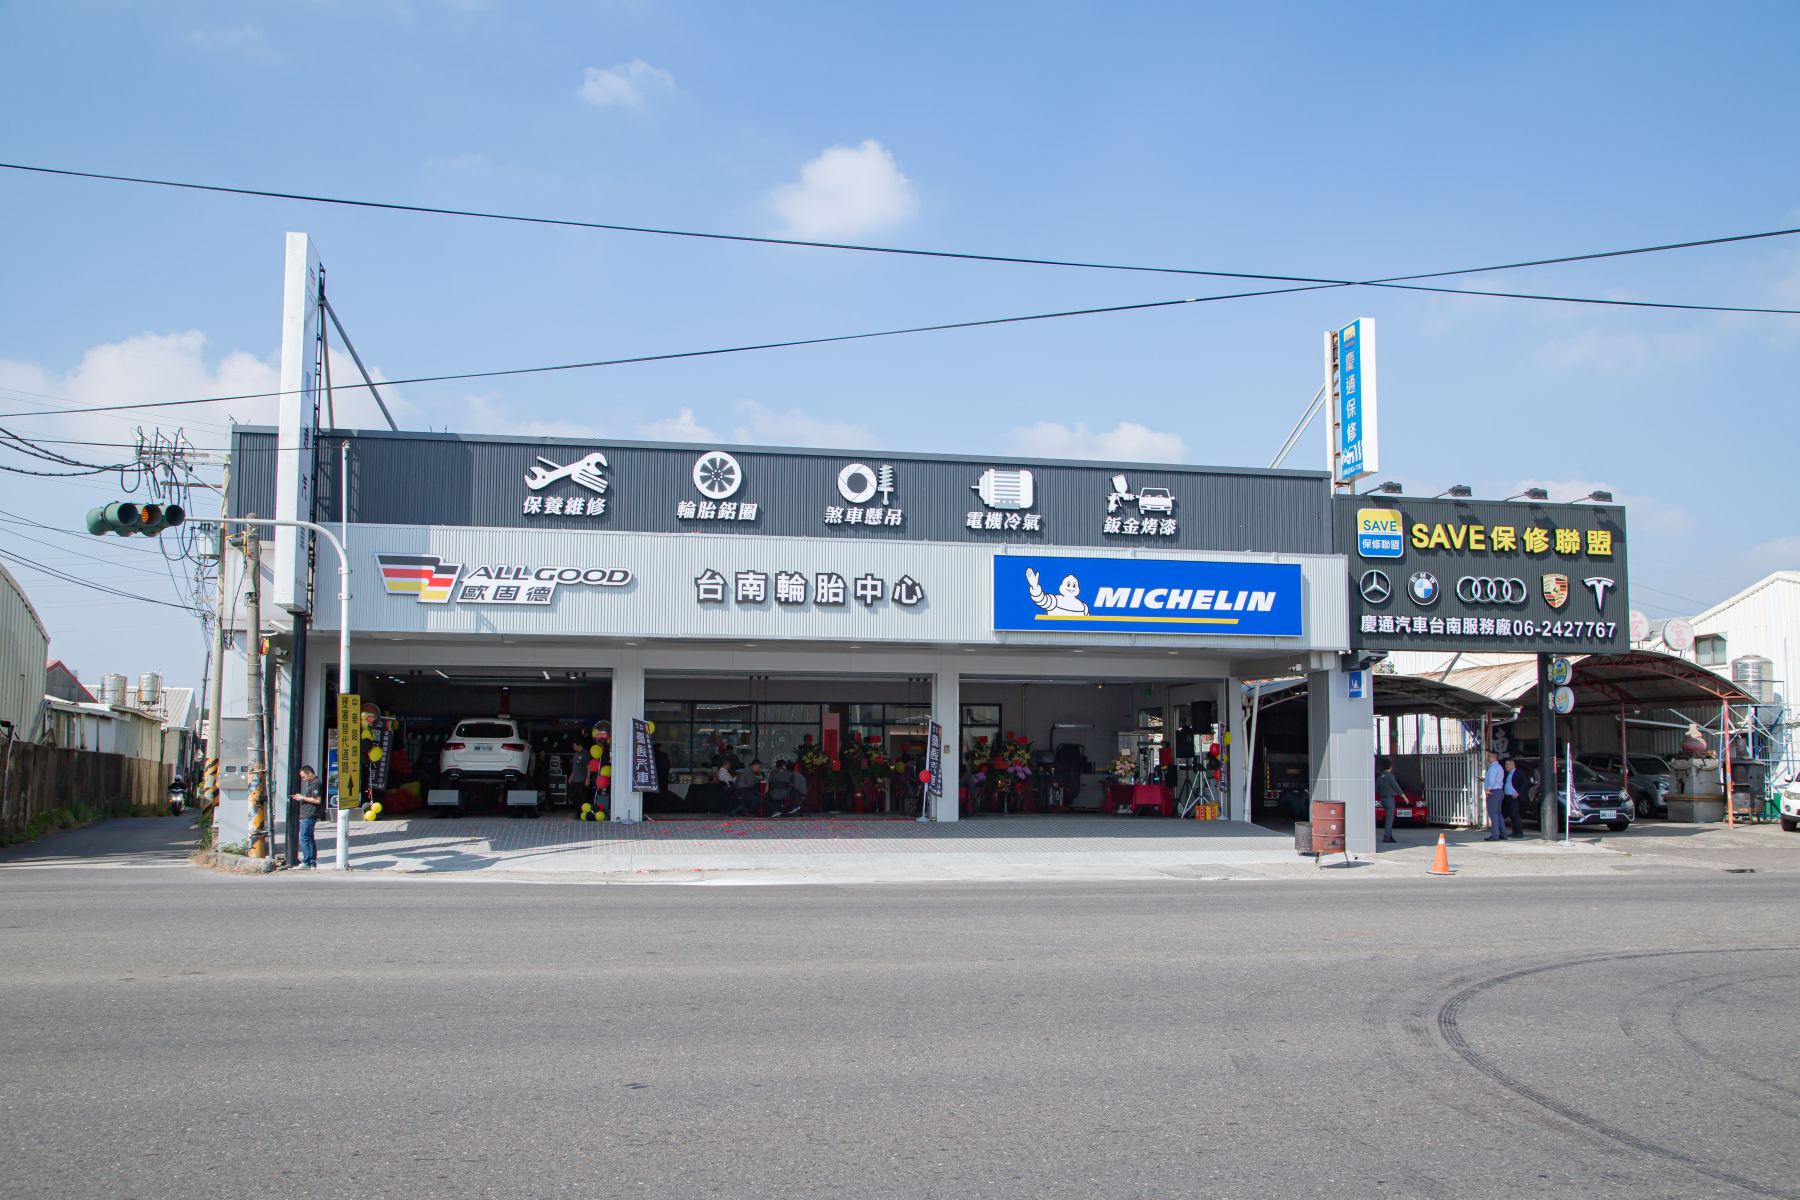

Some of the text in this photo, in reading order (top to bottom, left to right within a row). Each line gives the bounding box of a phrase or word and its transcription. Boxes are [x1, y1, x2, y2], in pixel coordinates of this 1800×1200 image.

[522, 496, 606, 516] 保養維修
[676, 501, 758, 521] 輪胎鋁圈
[824, 506, 903, 526] 煞車懸吊
[966, 511, 1042, 532] 電機冷氣
[1103, 516, 1178, 536] 鈑金烤漆
[1363, 519, 1397, 532] SAVE
[1362, 539, 1400, 550] 保修聯盟
[696, 569, 923, 606] 台南輪胎中心
[1410, 572, 1436, 584] BMW
[464, 585, 552, 602] 歐固德
[1094, 586, 1276, 612] MICHELIN
